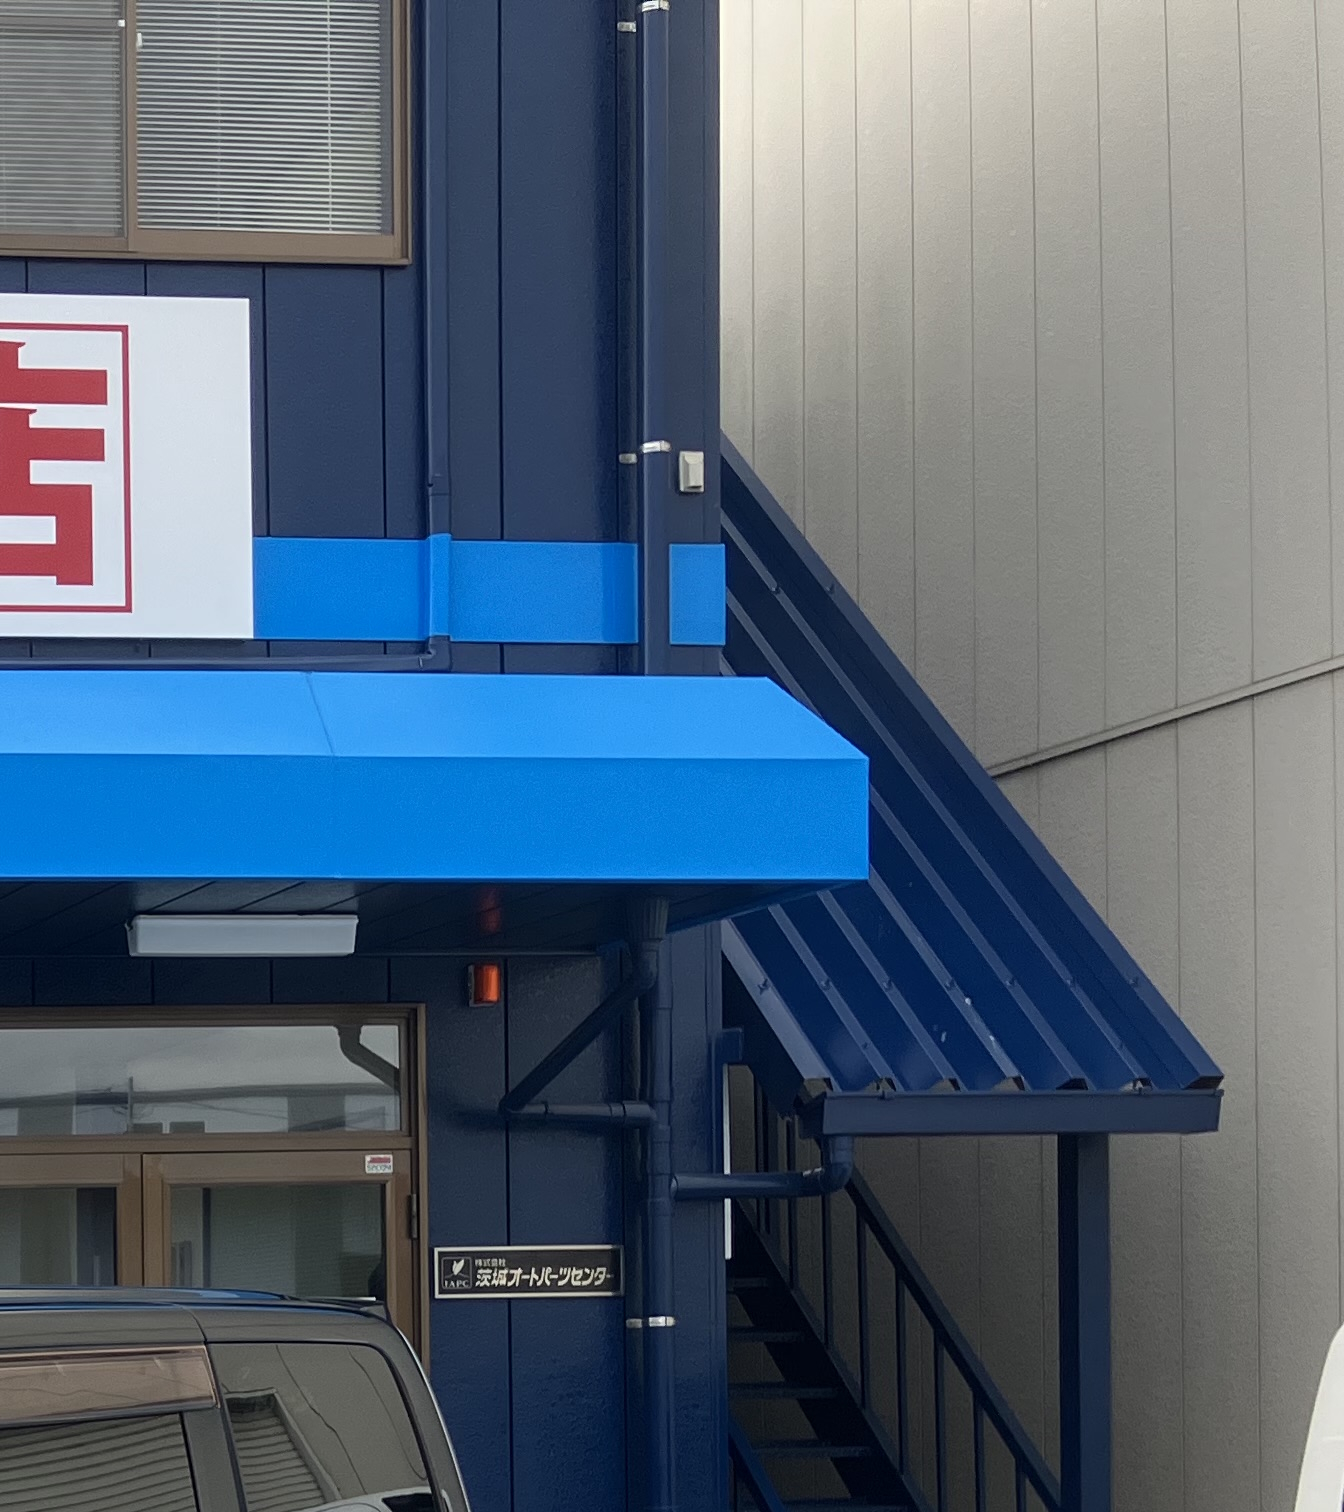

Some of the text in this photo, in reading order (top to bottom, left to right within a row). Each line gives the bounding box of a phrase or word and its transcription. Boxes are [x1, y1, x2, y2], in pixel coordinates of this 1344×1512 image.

[474, 1258, 506, 1267] 株式会社
[475, 1266, 614, 1288] 茨城オートパーツセンター
